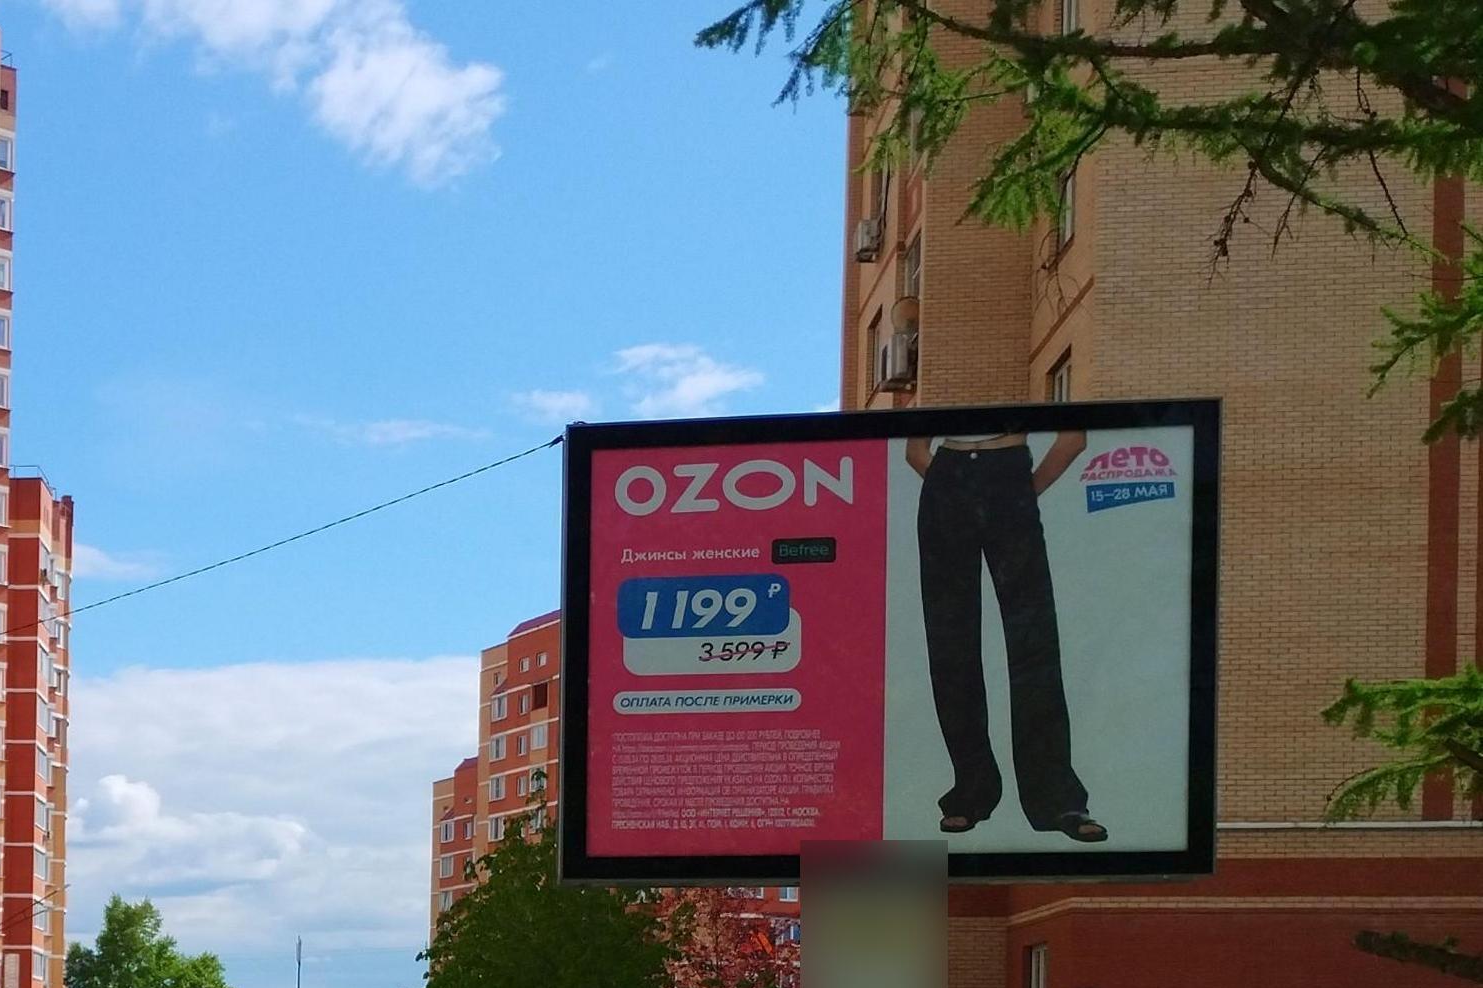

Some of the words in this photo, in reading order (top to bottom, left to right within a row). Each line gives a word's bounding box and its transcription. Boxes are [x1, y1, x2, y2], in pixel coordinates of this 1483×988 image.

[1080, 468, 1177, 482] РАСПРОДАЖА
[615, 456, 854, 516] OZON
[1134, 484, 1168, 497] МАЯ
[621, 548, 687, 564] Джинсы
[692, 546, 760, 560] женские
[779, 544, 830, 557] Befree
[620, 696, 671, 708] ОПЛАТА
[675, 695, 720, 707] ПОСЛЕ
[723, 694, 794, 706] ПРИМЕРКИ
